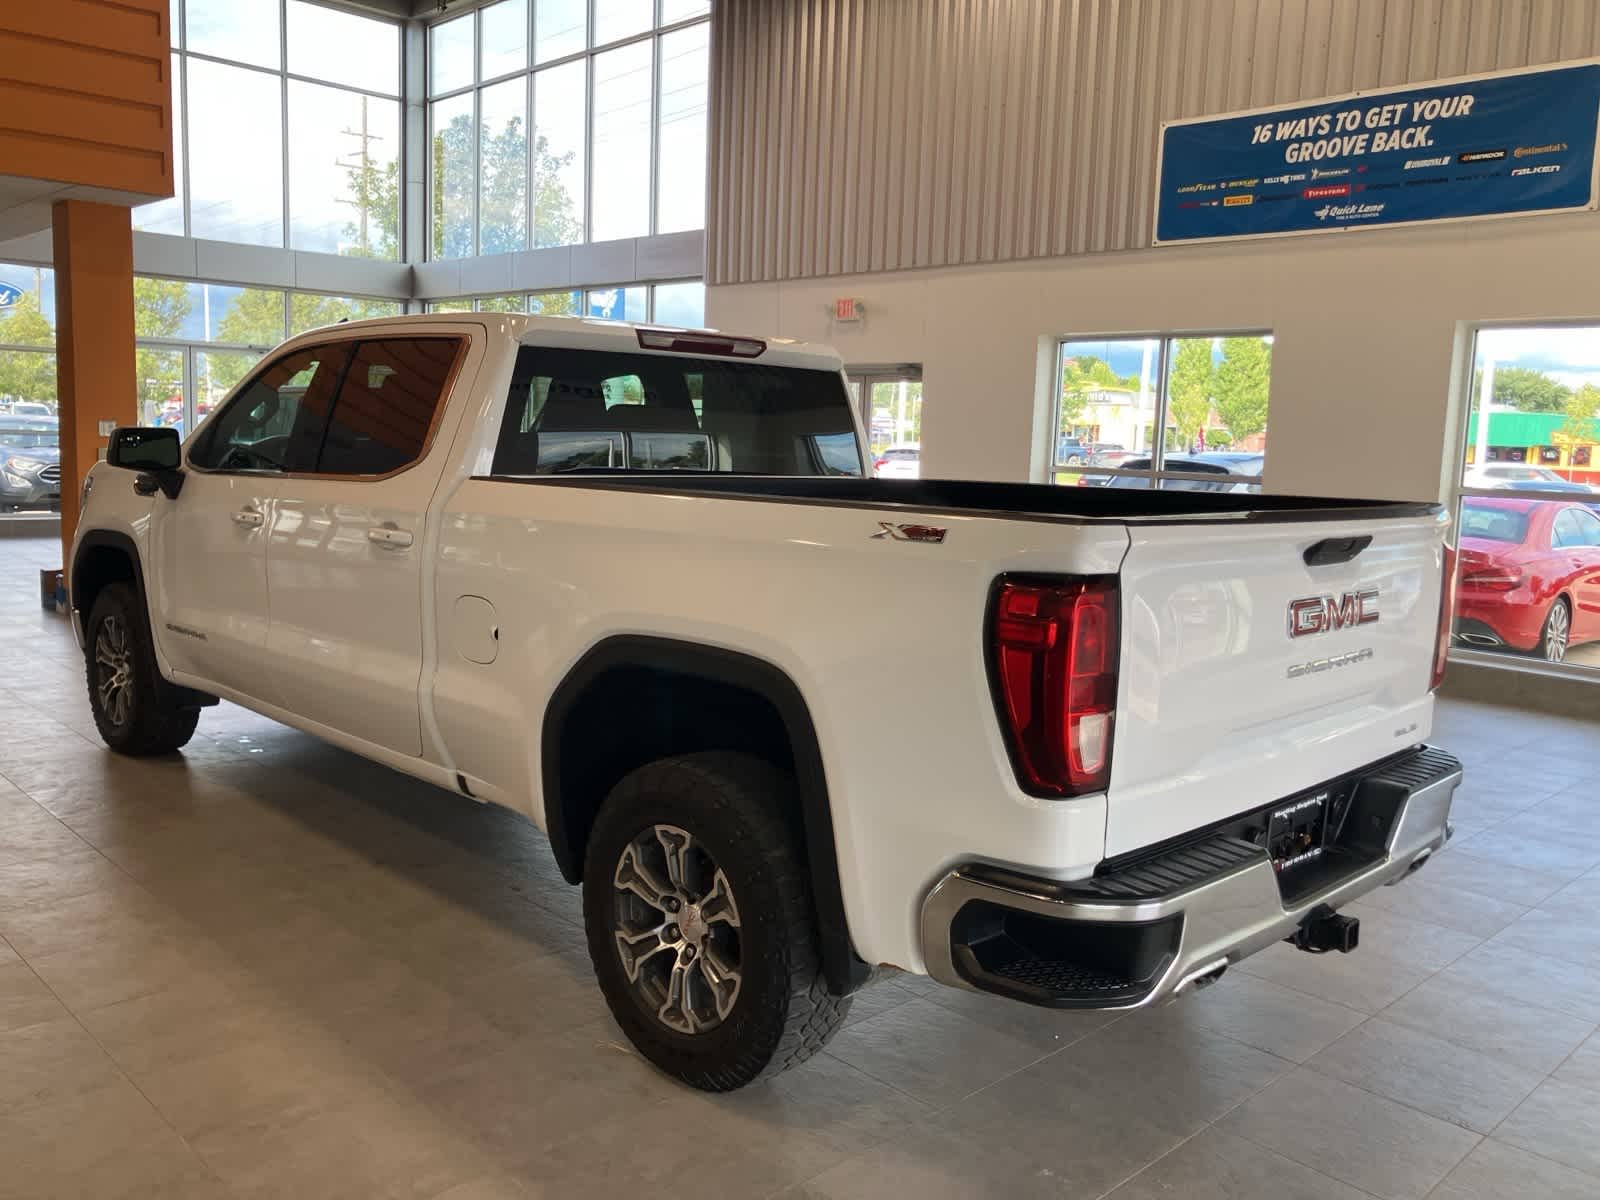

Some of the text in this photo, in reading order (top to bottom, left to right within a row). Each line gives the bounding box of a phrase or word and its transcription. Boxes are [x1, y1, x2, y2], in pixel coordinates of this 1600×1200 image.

[1251, 95, 1474, 145] 16 WAYS TO GET YOUR
[1285, 125, 1434, 164] GROOVE BACK.
[1468, 151, 1505, 160] HANKOOK
[1511, 165, 1561, 177] FALKEN
[1328, 203, 1358, 217] Quick
[1358, 202, 1385, 214] Lane
[1287, 590, 1380, 639] GMC
[1286, 647, 1374, 679] SIERRA
